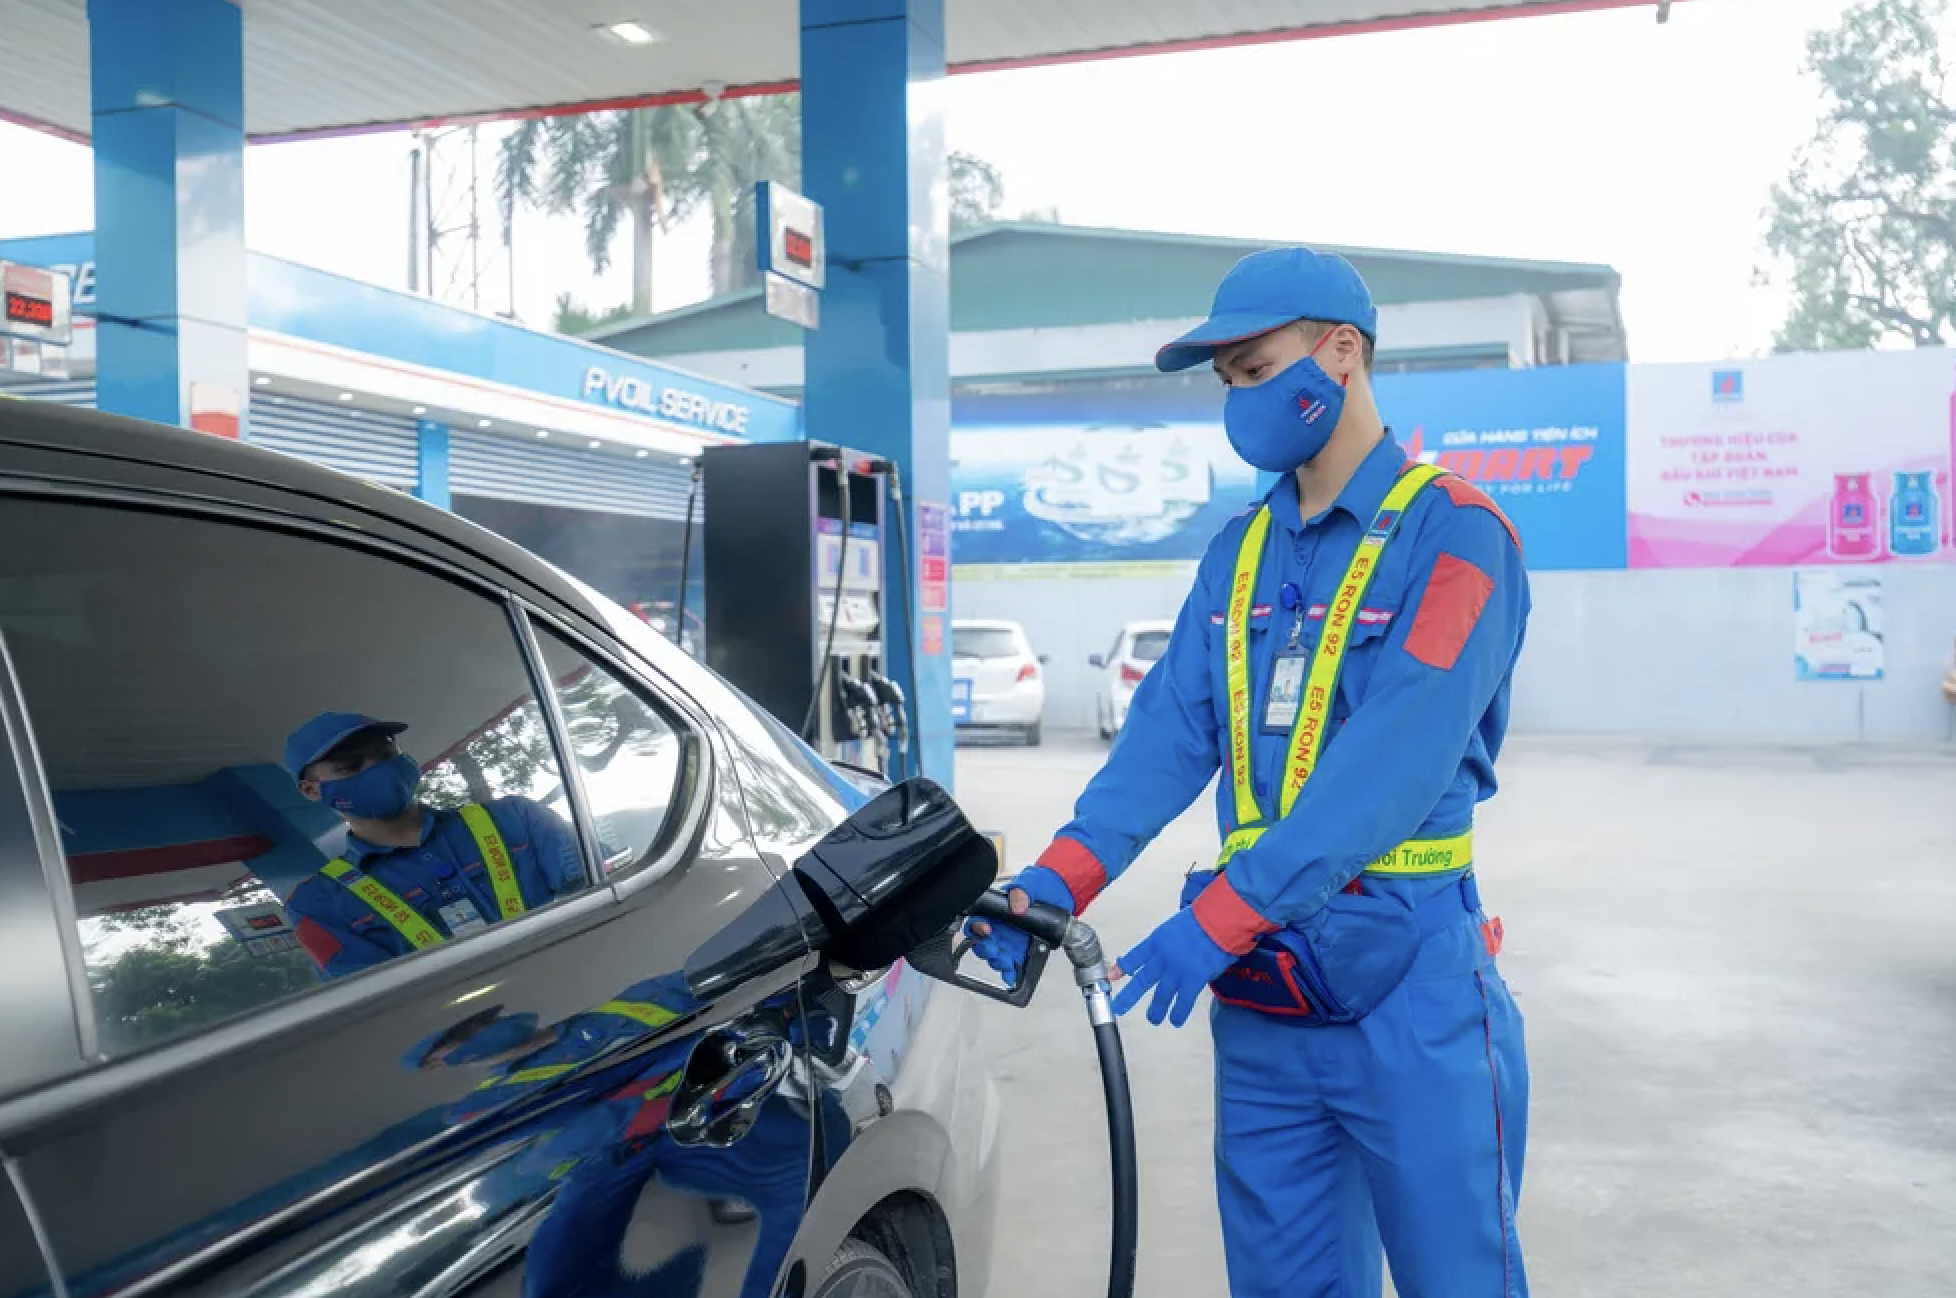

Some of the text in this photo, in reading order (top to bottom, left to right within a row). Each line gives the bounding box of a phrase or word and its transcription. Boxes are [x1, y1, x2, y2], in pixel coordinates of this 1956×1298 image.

[584, 366, 750, 434] PVOIL SERVICE
[1324, 558, 1370, 656] E5 RON 92
[1310, 686, 1325, 712] E5
[1296, 717, 1319, 762] RON
